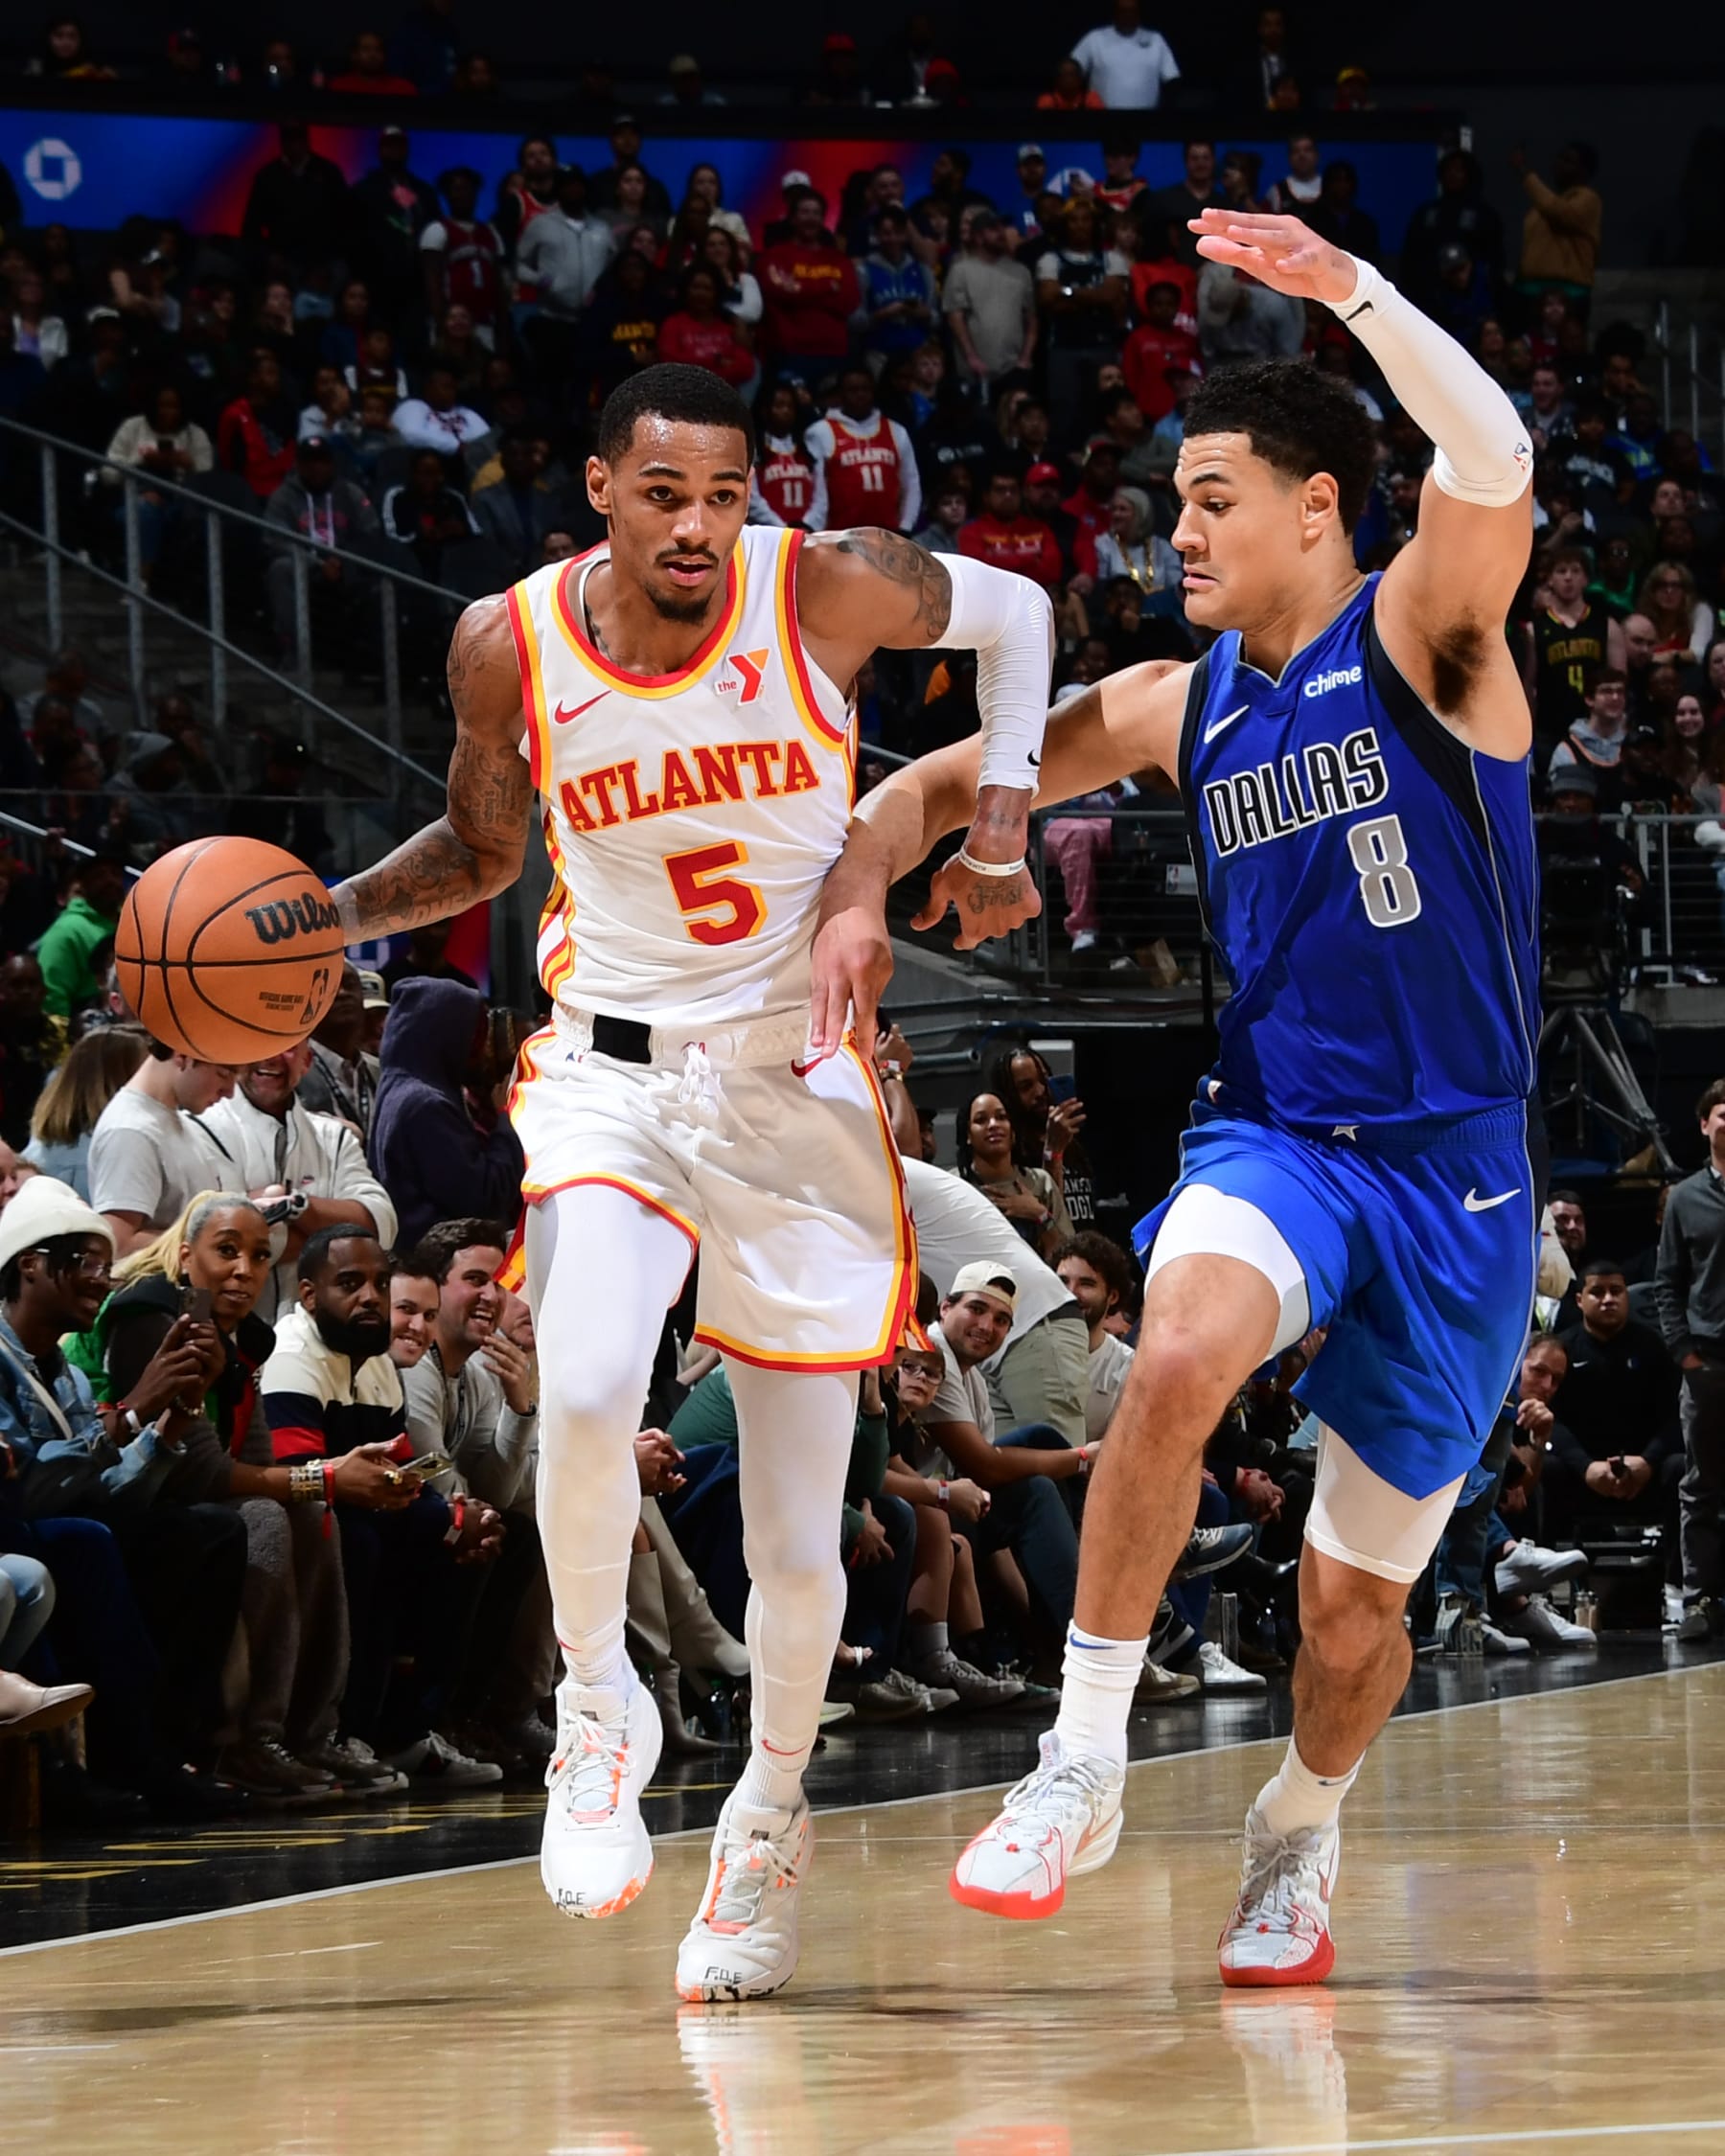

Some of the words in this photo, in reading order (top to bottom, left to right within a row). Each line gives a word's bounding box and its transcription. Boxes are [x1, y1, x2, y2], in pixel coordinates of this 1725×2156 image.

[840, 447, 896, 468] ATLANTA
[782, 480, 805, 508] 11
[861, 464, 886, 492] 11
[1547, 636, 1602, 665] ATLANTA
[717, 679, 737, 692] the
[1304, 665, 1363, 698] chime
[1567, 663, 1585, 695] 4
[558, 738, 820, 833] ATLANTA
[1202, 726, 1389, 858] DALLAS
[1346, 814, 1422, 928] 8
[661, 839, 768, 946] 5
[245, 892, 340, 945] Wilso
